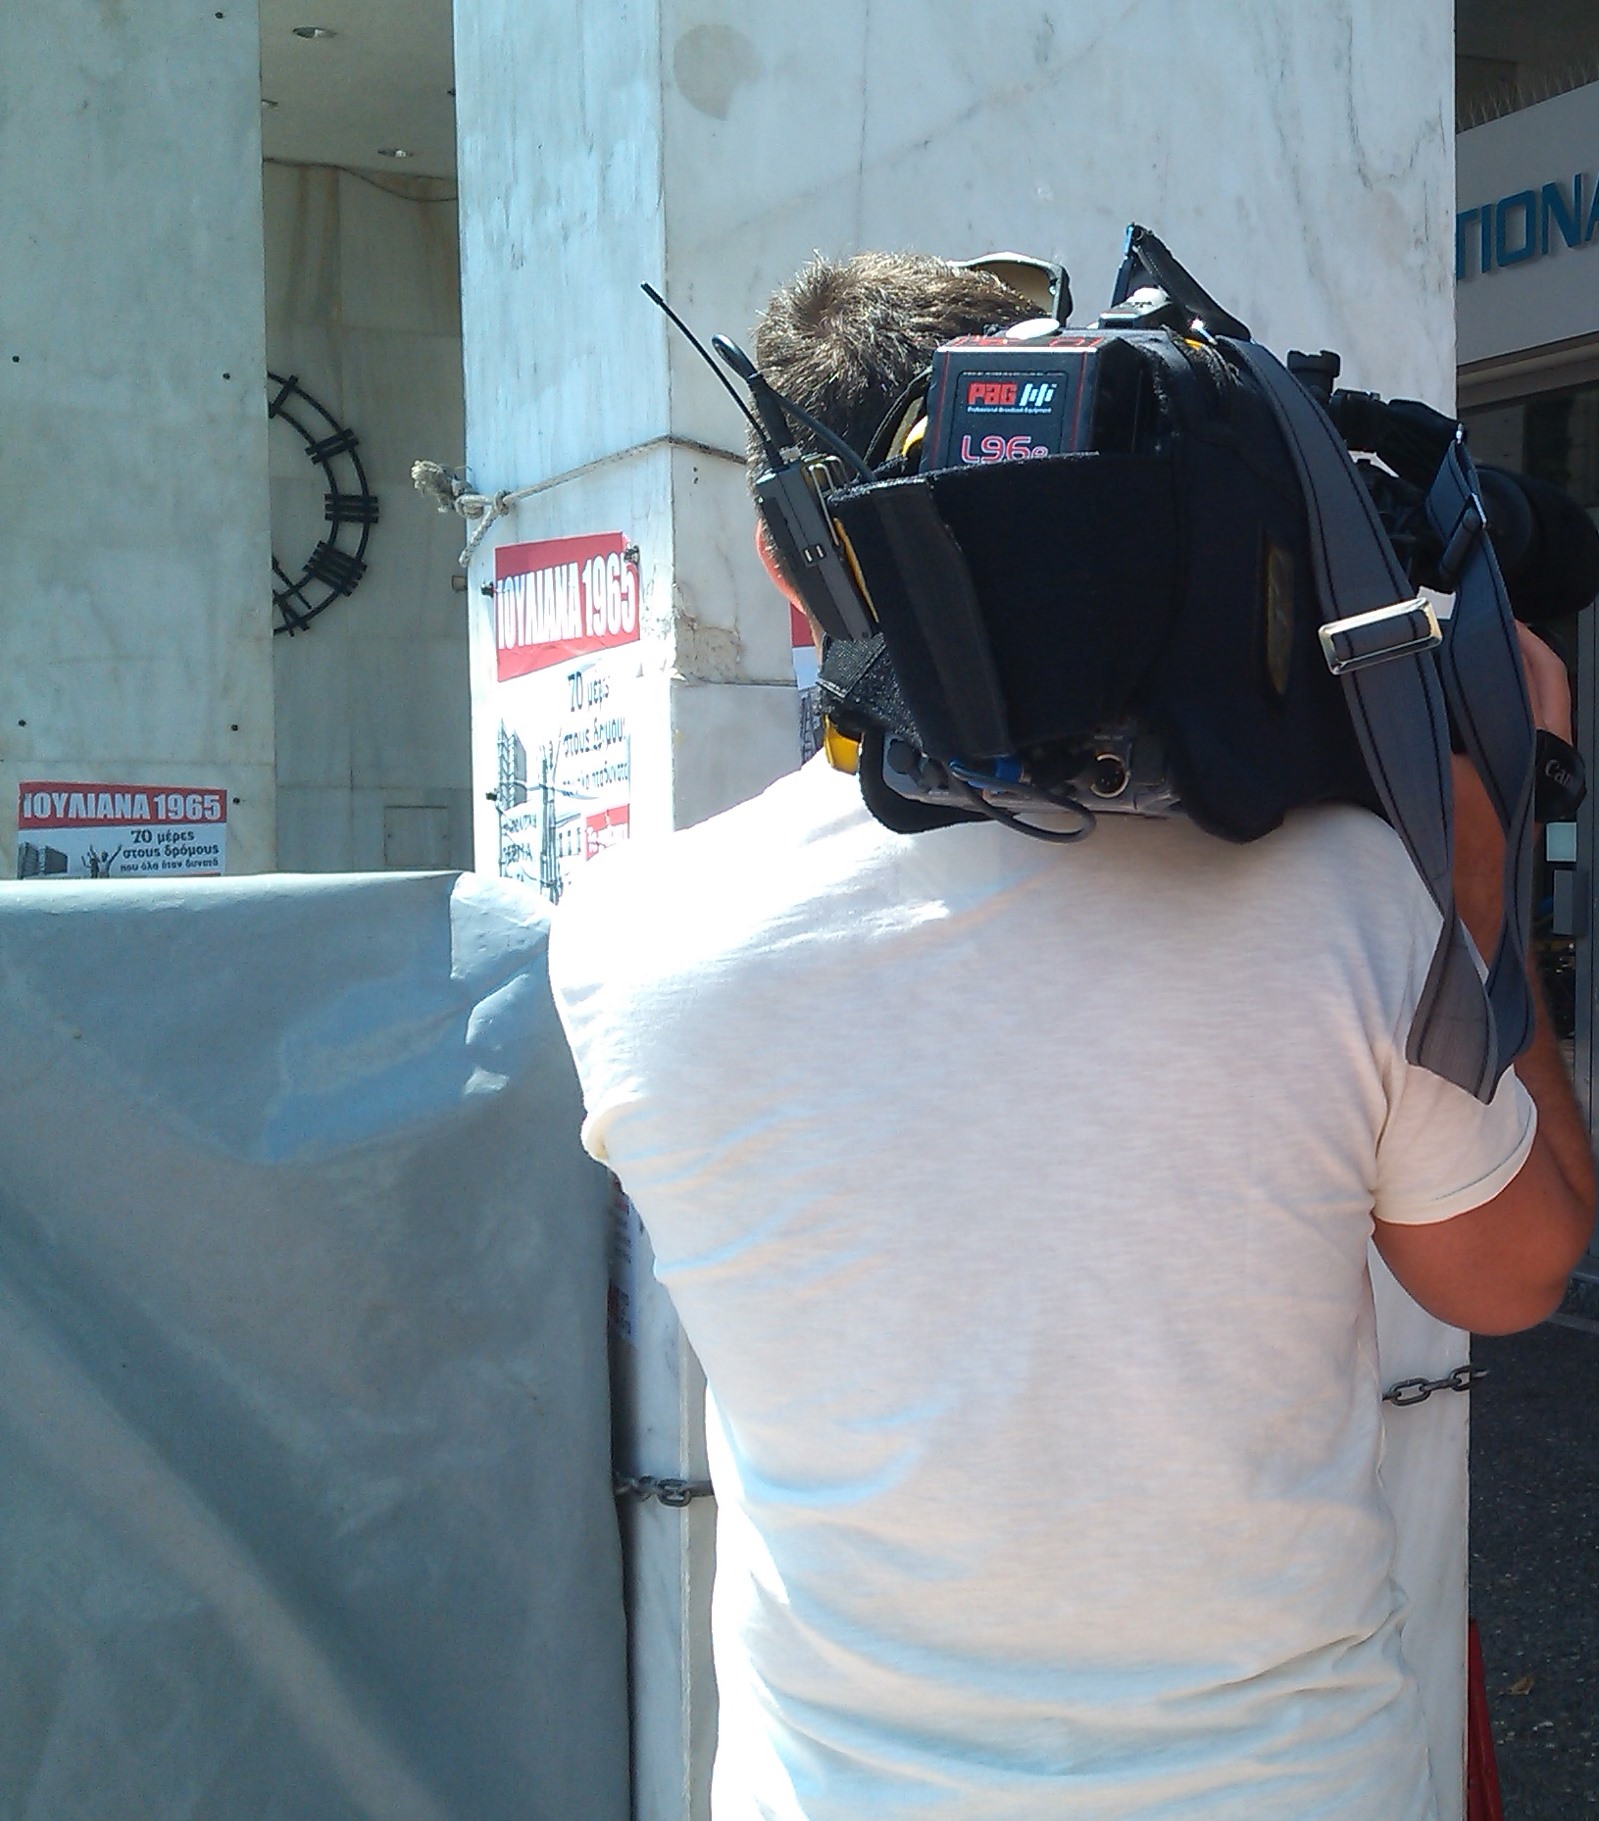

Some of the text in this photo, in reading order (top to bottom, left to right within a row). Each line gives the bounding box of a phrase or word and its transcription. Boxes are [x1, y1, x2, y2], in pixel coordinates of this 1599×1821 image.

[497, 552, 637, 650] ΙΟΥΛΙΑΝΑ 1965
[567, 671, 583, 712] 70
[23, 791, 221, 821] ΙΟΥΛΙΑΝΑ 1965
[123, 844, 220, 859] στους δρόμους
[130, 829, 195, 845] 70 μέρες
